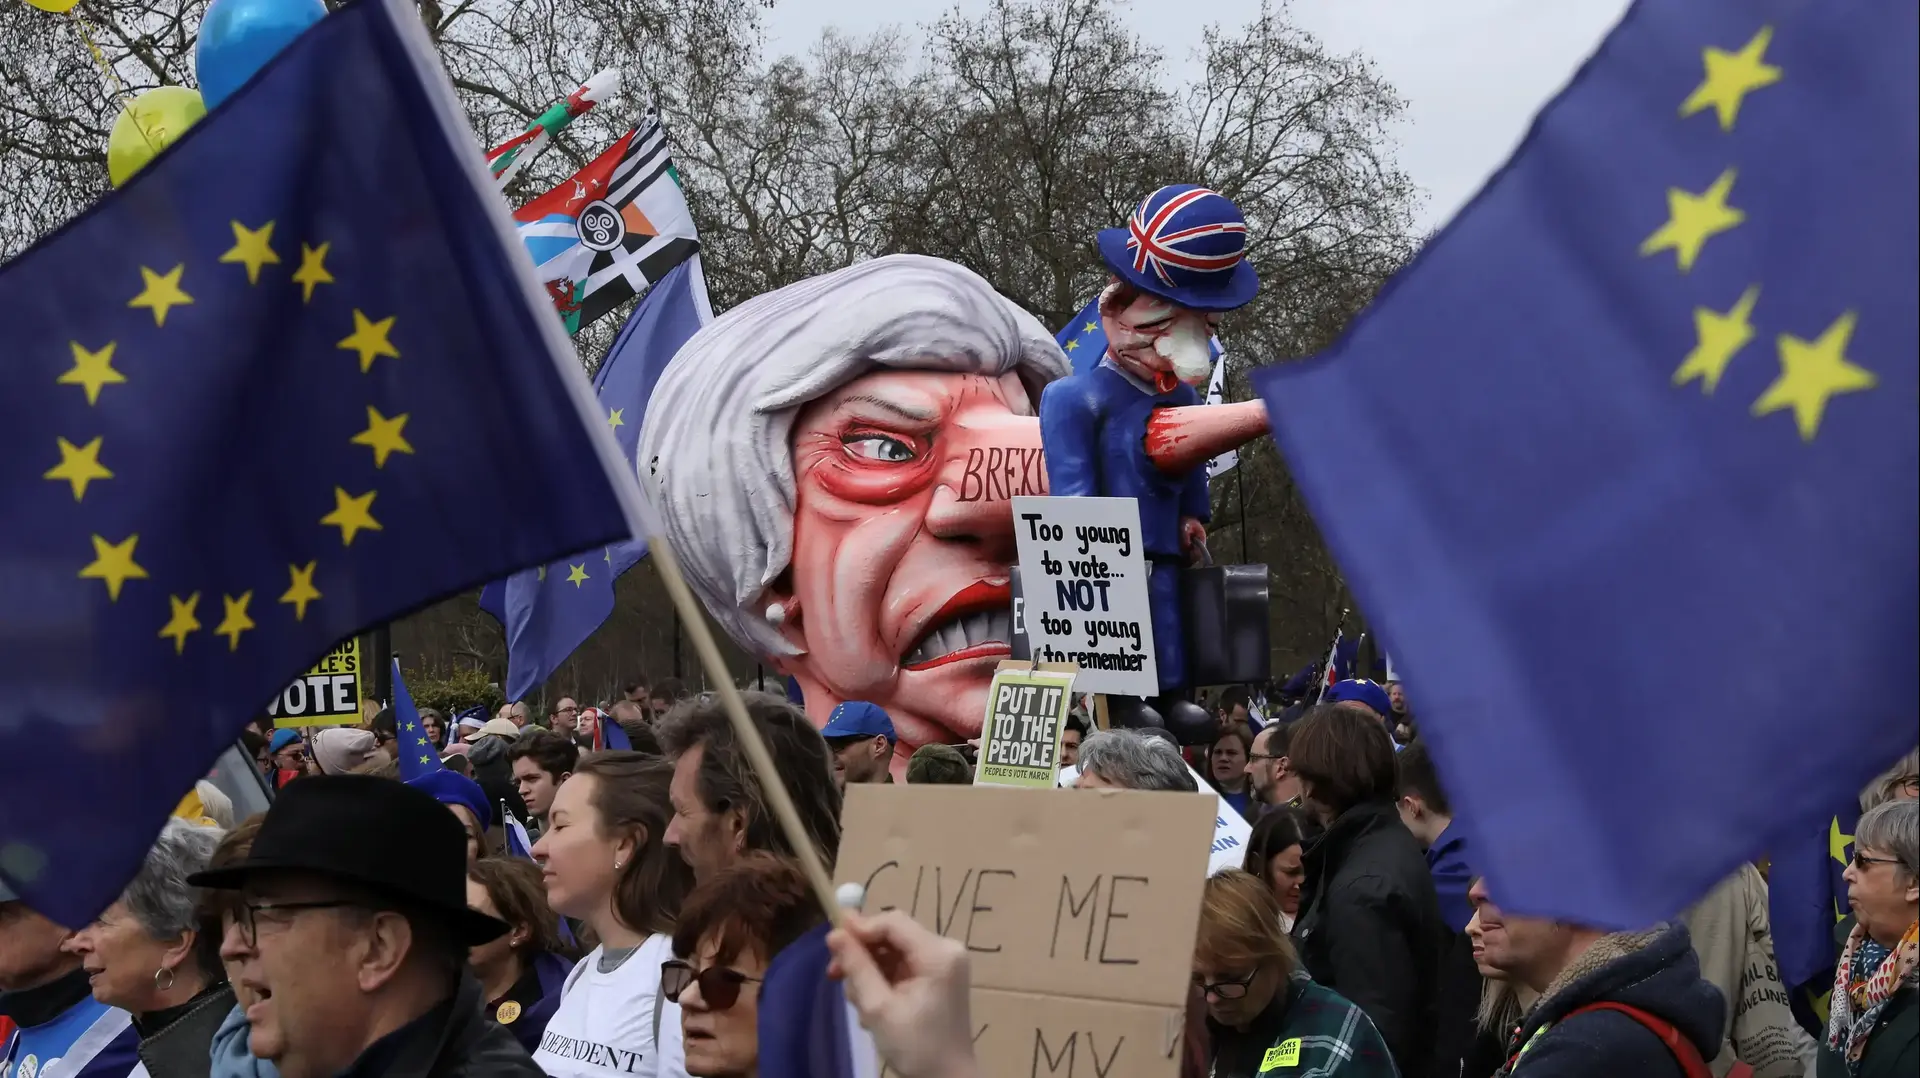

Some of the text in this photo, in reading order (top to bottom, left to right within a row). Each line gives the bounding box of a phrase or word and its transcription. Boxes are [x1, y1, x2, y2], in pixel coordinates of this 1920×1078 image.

[956, 447, 1047, 502] BREXI
[1021, 513, 1131, 557] Too young
[1041, 550, 1124, 578] to vote...
[1056, 579, 1110, 612] NOT
[1041, 612, 1142, 650] too young
[1044, 644, 1147, 672] to remember
[996, 685, 1062, 716] PUT IT
[994, 713, 1057, 743] TO THE
[987, 739, 1054, 768] PEOPLE
[984, 766, 1050, 780] PEOPLE'S VOTE MARCH
[859, 860, 1149, 965] GIVE ME
